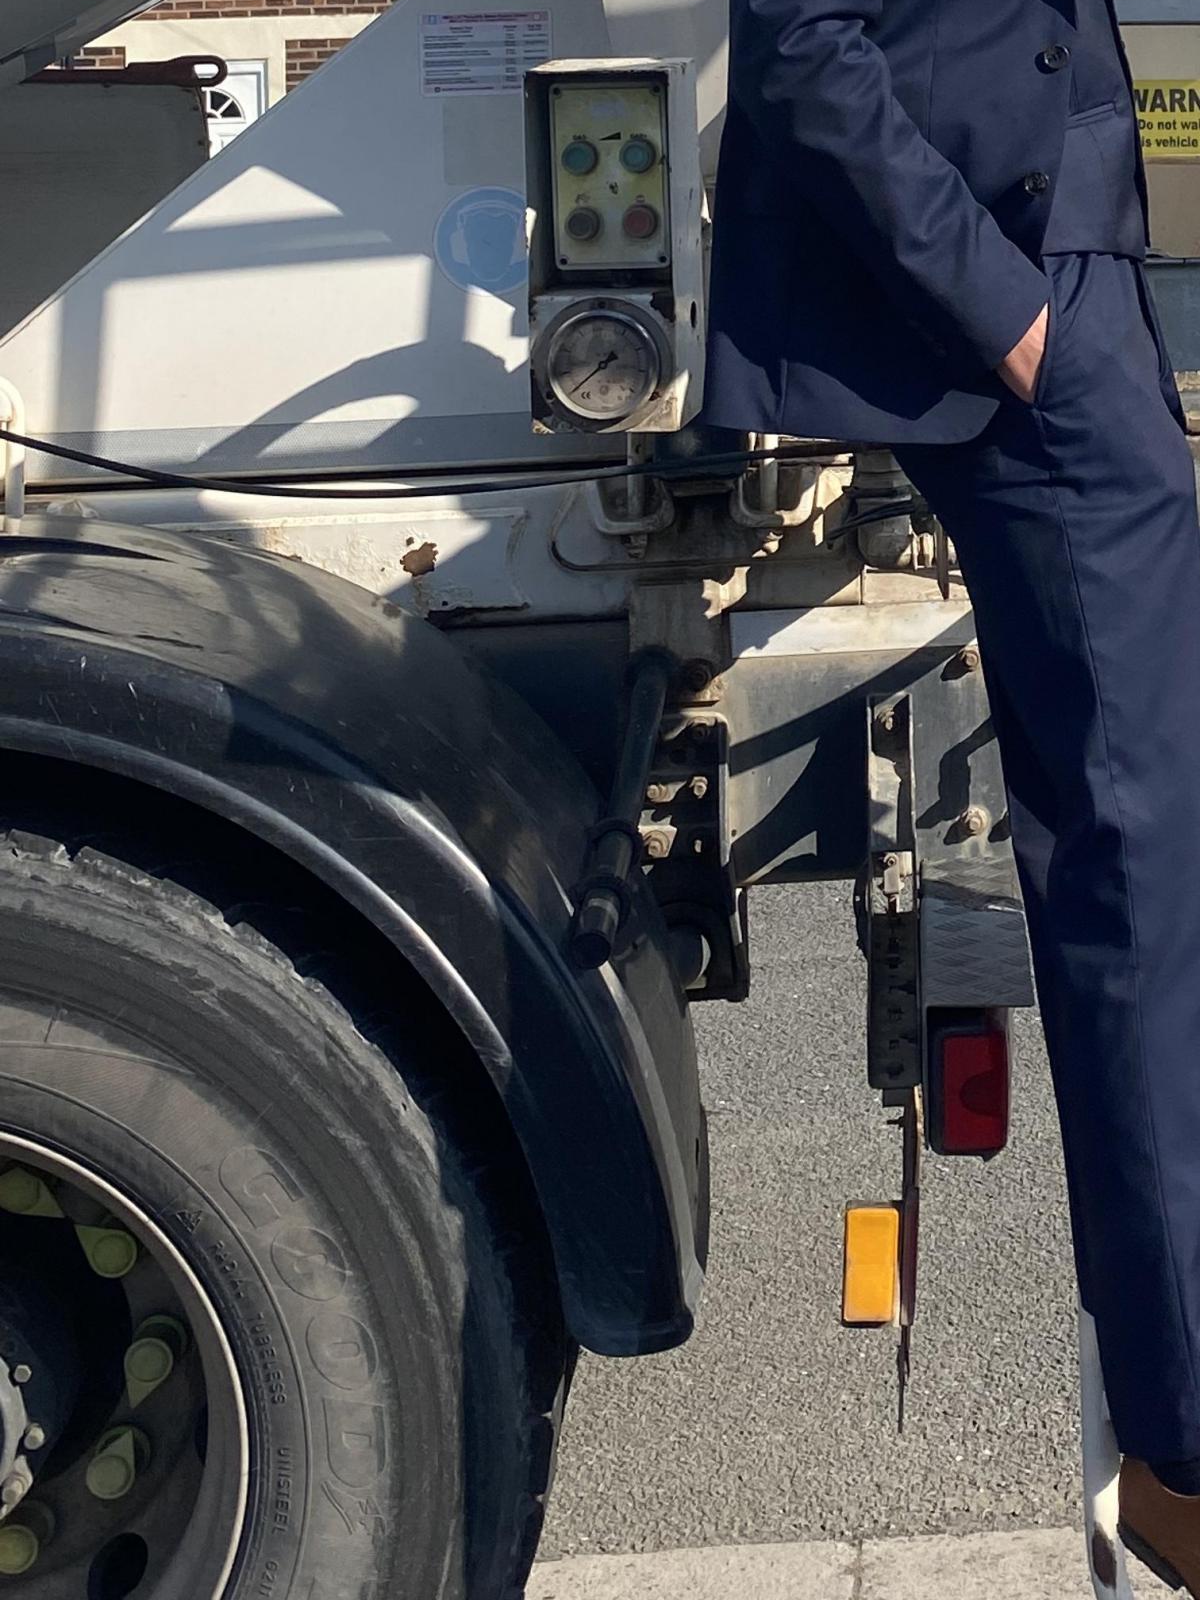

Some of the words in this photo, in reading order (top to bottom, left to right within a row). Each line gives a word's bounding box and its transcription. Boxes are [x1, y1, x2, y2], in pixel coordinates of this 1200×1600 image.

[1138, 119, 1154, 131] Do
[1157, 119, 1178, 131] not
[1140, 136, 1152, 148] is
[1155, 136, 1199, 148] vehicle
[248, 1310, 289, 1406] TUBELESS
